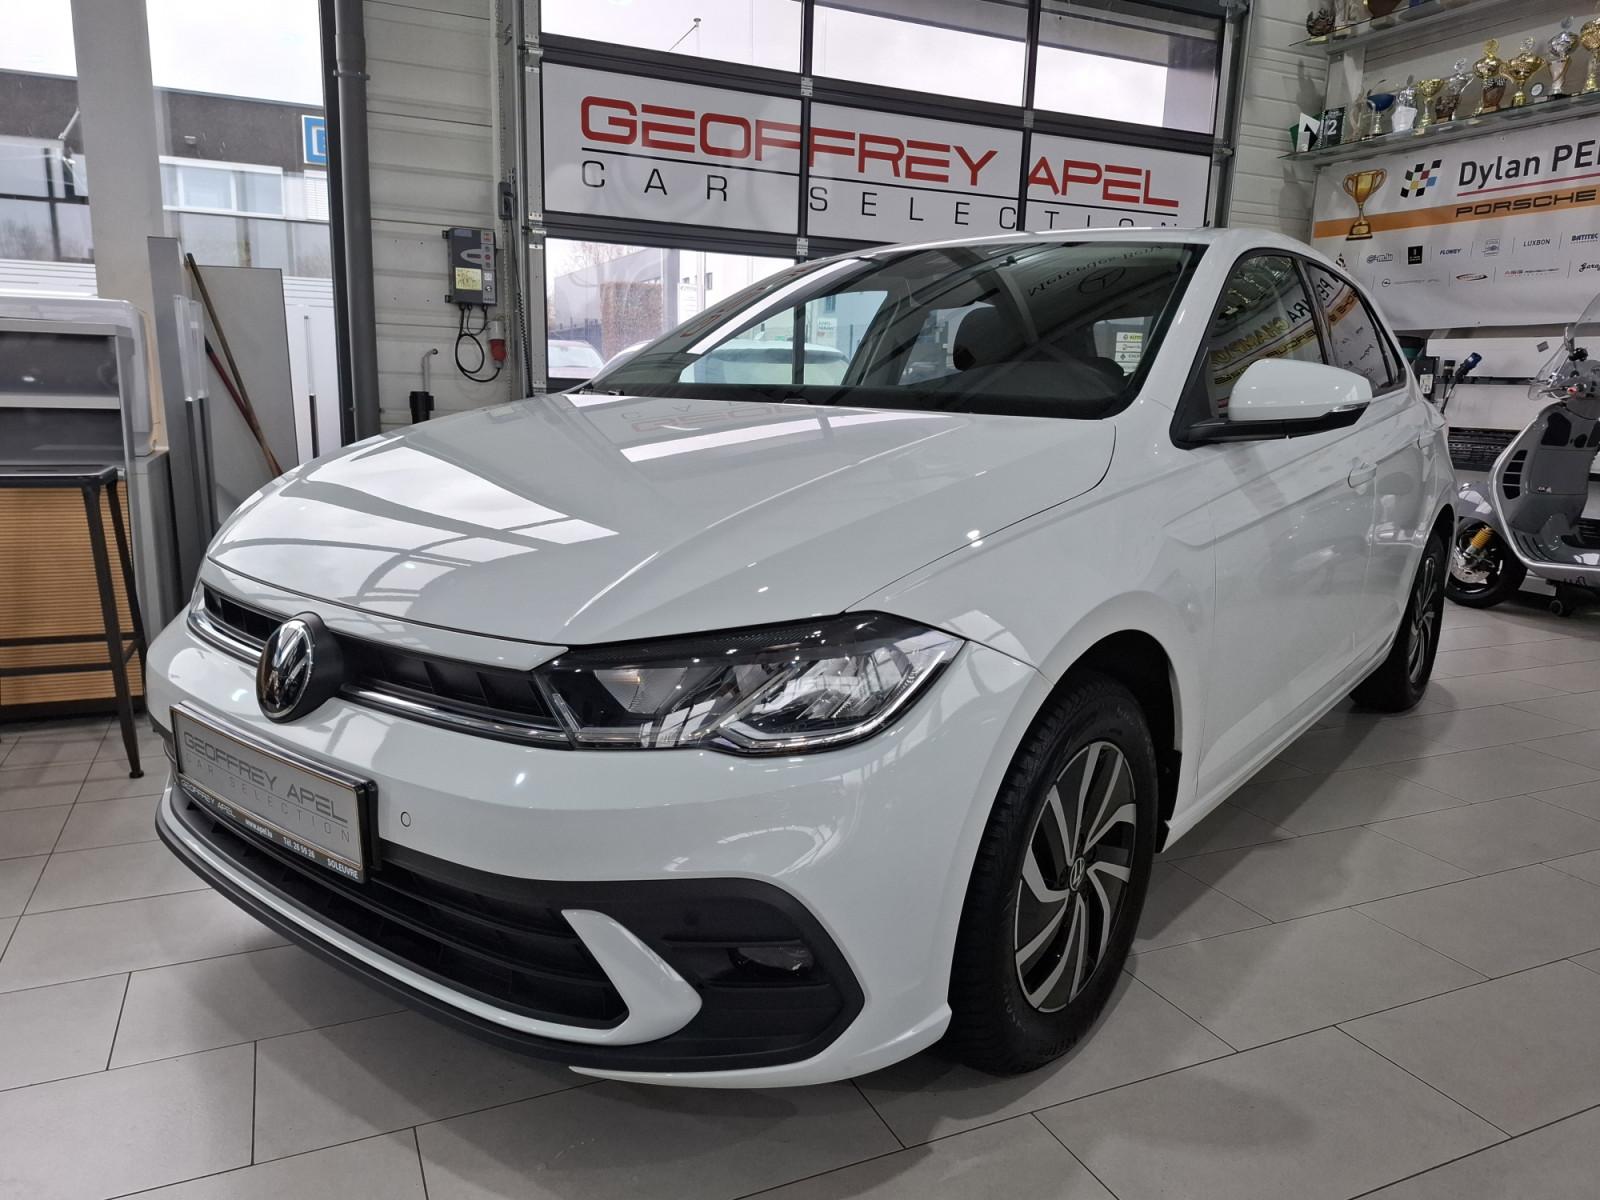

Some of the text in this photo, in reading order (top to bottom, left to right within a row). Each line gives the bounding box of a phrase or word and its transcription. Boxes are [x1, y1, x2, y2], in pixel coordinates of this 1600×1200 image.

[581, 96, 1179, 207] GEOFFREY APEL
[1459, 140, 1600, 189] Dylan PE
[582, 160, 1178, 229] CAR SELECTI
[1456, 189, 1595, 217] PORSCHE
[1523, 239, 1551, 248] LUXBON
[184, 731, 348, 824] GEOFFREY APEL
[229, 776, 351, 843] SELECTION
[327, 857, 359, 879] SOLEUVRE
